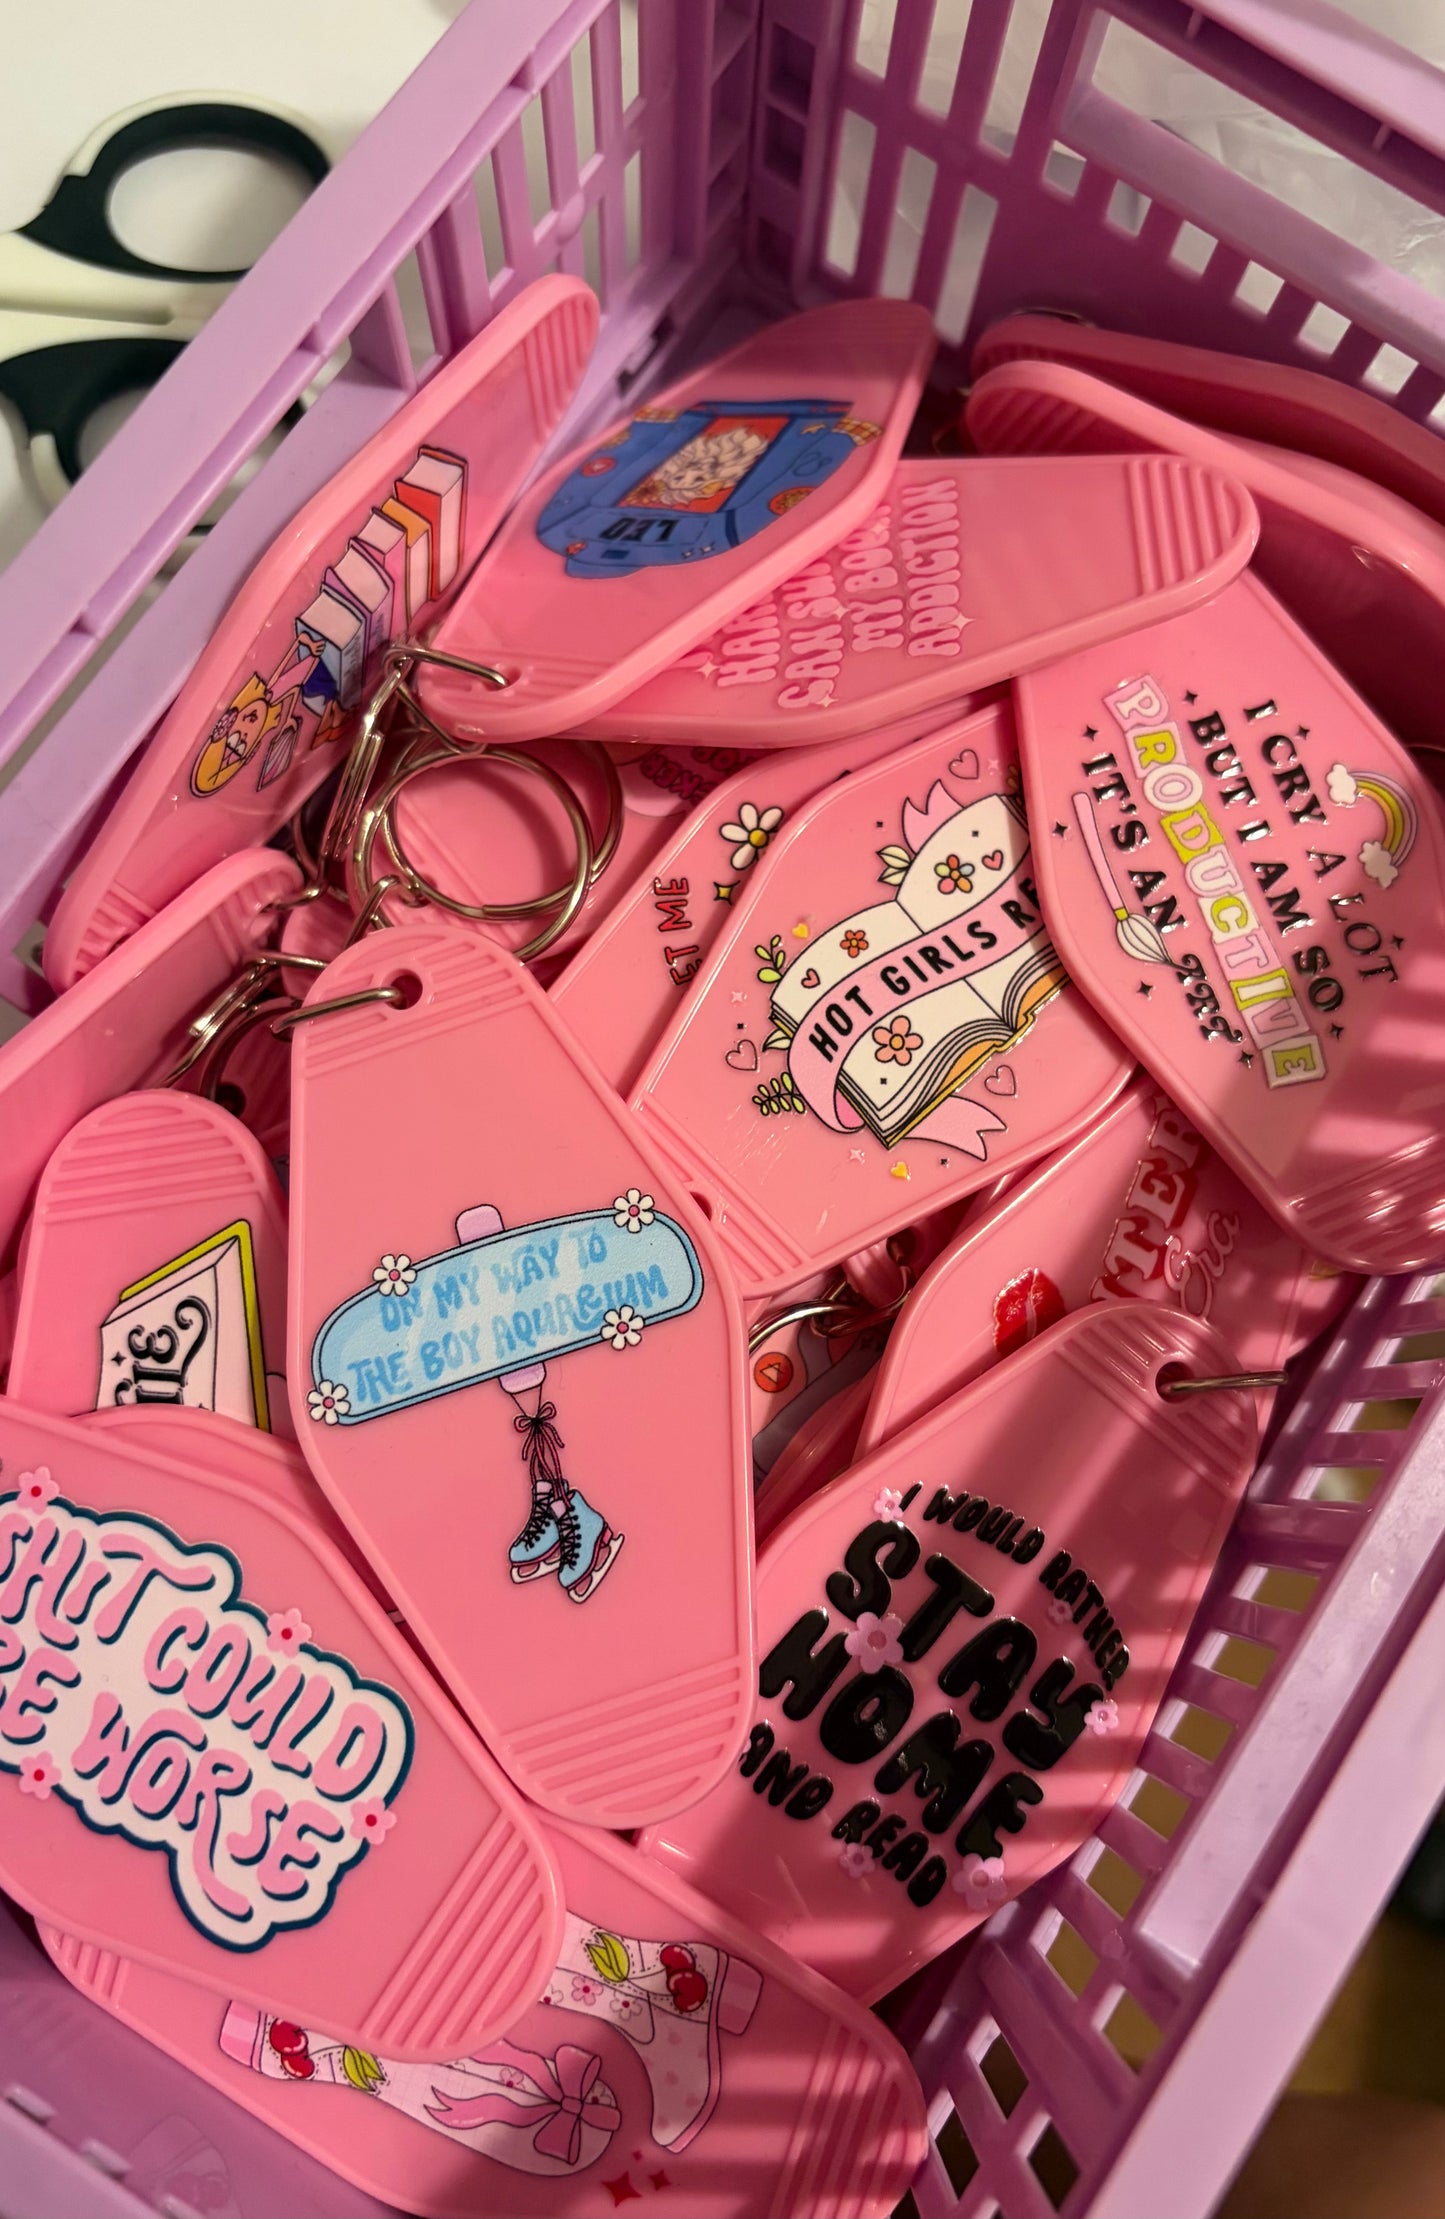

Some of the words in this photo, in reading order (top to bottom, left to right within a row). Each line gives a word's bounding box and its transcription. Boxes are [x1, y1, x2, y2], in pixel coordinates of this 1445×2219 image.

[850, 599, 903, 651] MY
[899, 479, 961, 656] ADDICTION
[717, 592, 781, 687] HAR
[778, 623, 845, 708] CAN
[1188, 710, 1258, 809] BUT
[1082, 752, 1150, 853] IT'S
[1128, 869, 1190, 935] AN
[1106, 677, 1322, 1084] PRODUCTIVE
[1236, 819, 1273, 845] I
[1243, 699, 1278, 723] I
[1261, 734, 1330, 826] CRY
[1306, 848, 1346, 882] A
[1328, 892, 1398, 983] LOT
[1250, 860, 1316, 937] AM
[654, 877, 692, 932] ME
[808, 985, 874, 1063] HOT
[880, 921, 998, 996] GIRLS
[1292, 945, 1344, 1013] SO
[347, 1350, 412, 1403] THE
[419, 1321, 481, 1381] BOY
[492, 1263, 670, 1358] AQUARIUM
[379, 1285, 422, 1333] ON
[432, 1266, 480, 1319] MY
[490, 1237, 560, 1294] WAY
[569, 1223, 608, 1270] TO
[826, 1519, 1105, 1771] STAY
[899, 1481, 924, 1512] I
[922, 1484, 1046, 1565] WOULD
[1038, 1549, 1131, 1691] RATHER
[144, 1606, 387, 1802] COULD
[759, 1607, 1045, 1862] HOME
[71, 1691, 345, 1922] WORSE
[739, 1720, 834, 1820] AND
[831, 1796, 948, 1907] READ
